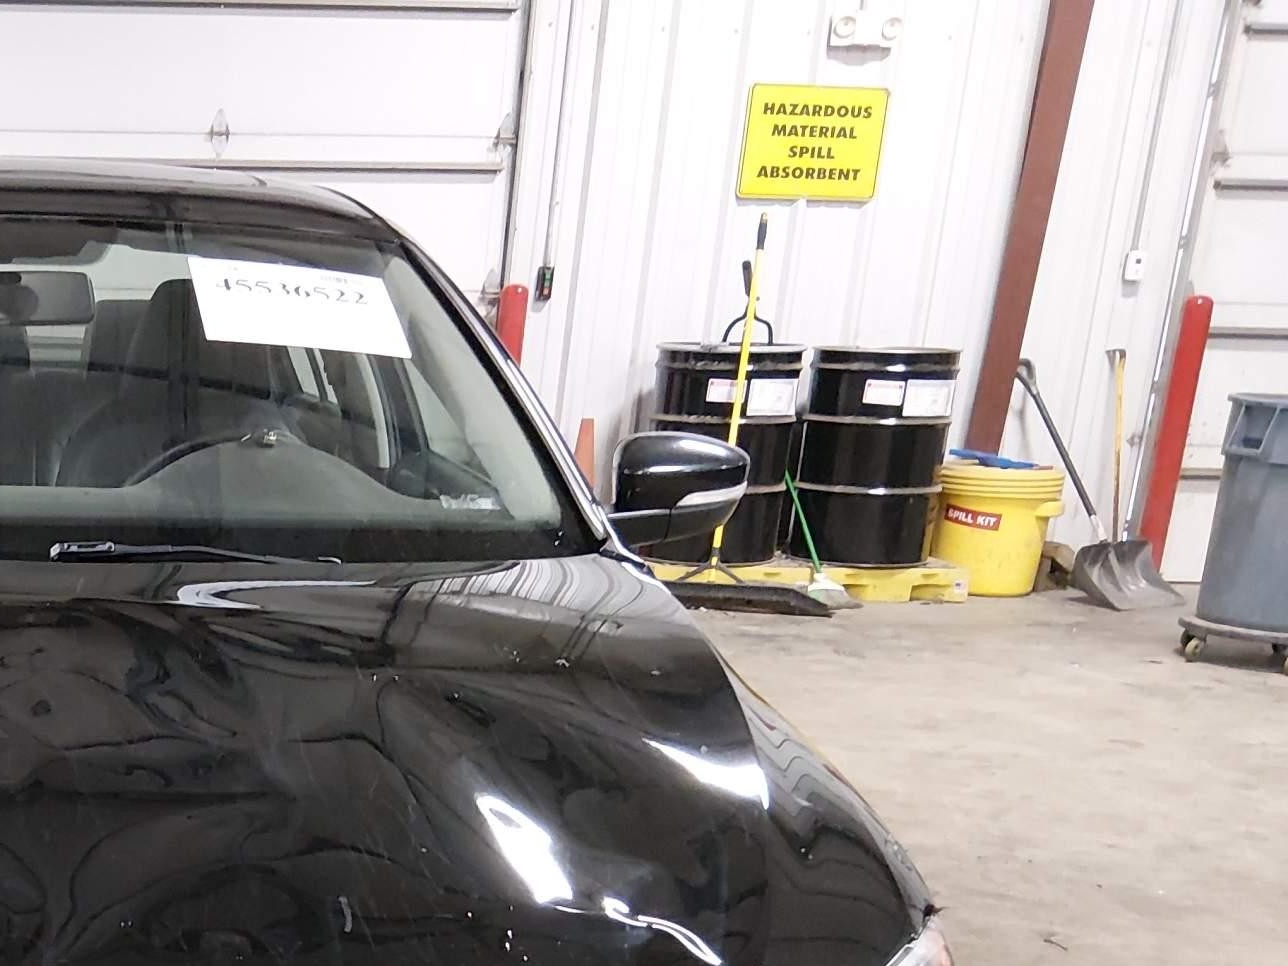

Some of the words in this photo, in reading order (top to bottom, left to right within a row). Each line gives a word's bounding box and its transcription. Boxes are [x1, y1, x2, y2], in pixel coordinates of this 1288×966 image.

[763, 102, 873, 119] HAZARDOUS
[771, 123, 858, 139] MATERIAL
[787, 145, 836, 160] SPILL
[756, 165, 861, 181] ABSORBENT
[215, 277, 369, 305] 45536522
[948, 508, 974, 524] SPILL
[976, 514, 998, 527] KIT
